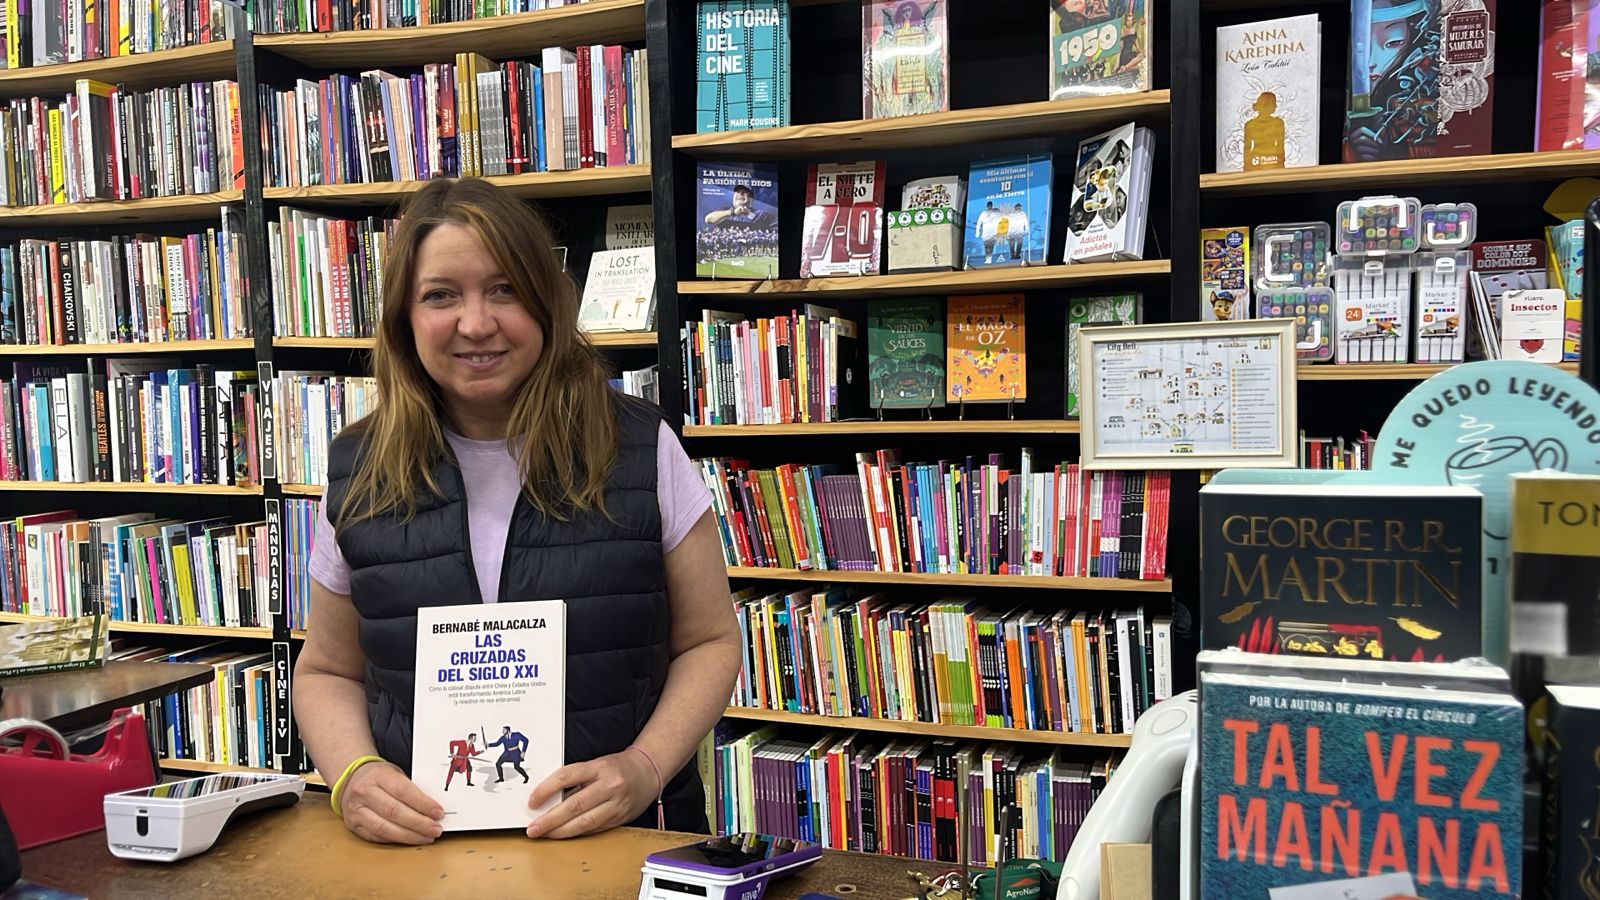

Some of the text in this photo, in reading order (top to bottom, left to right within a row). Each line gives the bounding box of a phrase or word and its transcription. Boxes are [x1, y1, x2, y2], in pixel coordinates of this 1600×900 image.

[706, 8, 780, 29] HISTORIA
[706, 33, 738, 52] DEL
[1242, 28, 1289, 46] ANNA
[1449, 29, 1485, 42] MUJERES
[1224, 41, 1307, 63] KARENINA
[706, 55, 743, 74] CINE
[750, 117, 780, 127] COUSINS
[703, 168, 752, 178] LA ÚLTIMA
[818, 173, 874, 188] EL SIETE
[703, 177, 772, 188] PASIÓN DE DIOS
[1000, 181, 1012, 192] 10
[823, 187, 832, 200] A
[1079, 234, 1108, 246] Adictos
[1073, 241, 1113, 256] en pañales
[1482, 243, 1532, 254] DOUBLE SIX
[1484, 250, 1529, 260] COLOR DOT
[609, 255, 640, 268] LOST
[1476, 256, 1537, 269] DOMINOES
[603, 266, 650, 278] TRANSLATION
[63, 272, 76, 332] CHAIKOVSKI
[1511, 303, 1558, 312] Insectos
[1346, 310, 1359, 319] 24
[889, 323, 923, 334] VIENTO
[959, 321, 1013, 333] EL MAGO
[889, 338, 926, 352] SAUCES
[977, 330, 1006, 345] OZ
[55, 388, 68, 440] ELLA
[261, 380, 273, 459] VIAJES
[1390, 377, 1600, 469] ME QUEDO LEYENDO
[97, 424, 108, 454] BEATLES
[1221, 515, 1374, 551] GEORGE
[268, 513, 279, 600] MANDALAS
[1218, 552, 1463, 609] MARTIN
[432, 618, 546, 634] BERNABÉ MALACALZA
[475, 634, 502, 648] LAS
[451, 649, 526, 666] CRUZADAS
[438, 665, 539, 683] DEL SIGLO XXI
[277, 660, 287, 739] CINE TV
[1249, 695, 1477, 724] POR LA AUTORA DE ROMPER EL CÍRCULO
[1223, 719, 1501, 812] TAL VEZ
[1216, 793, 1510, 893] MAÑANA
